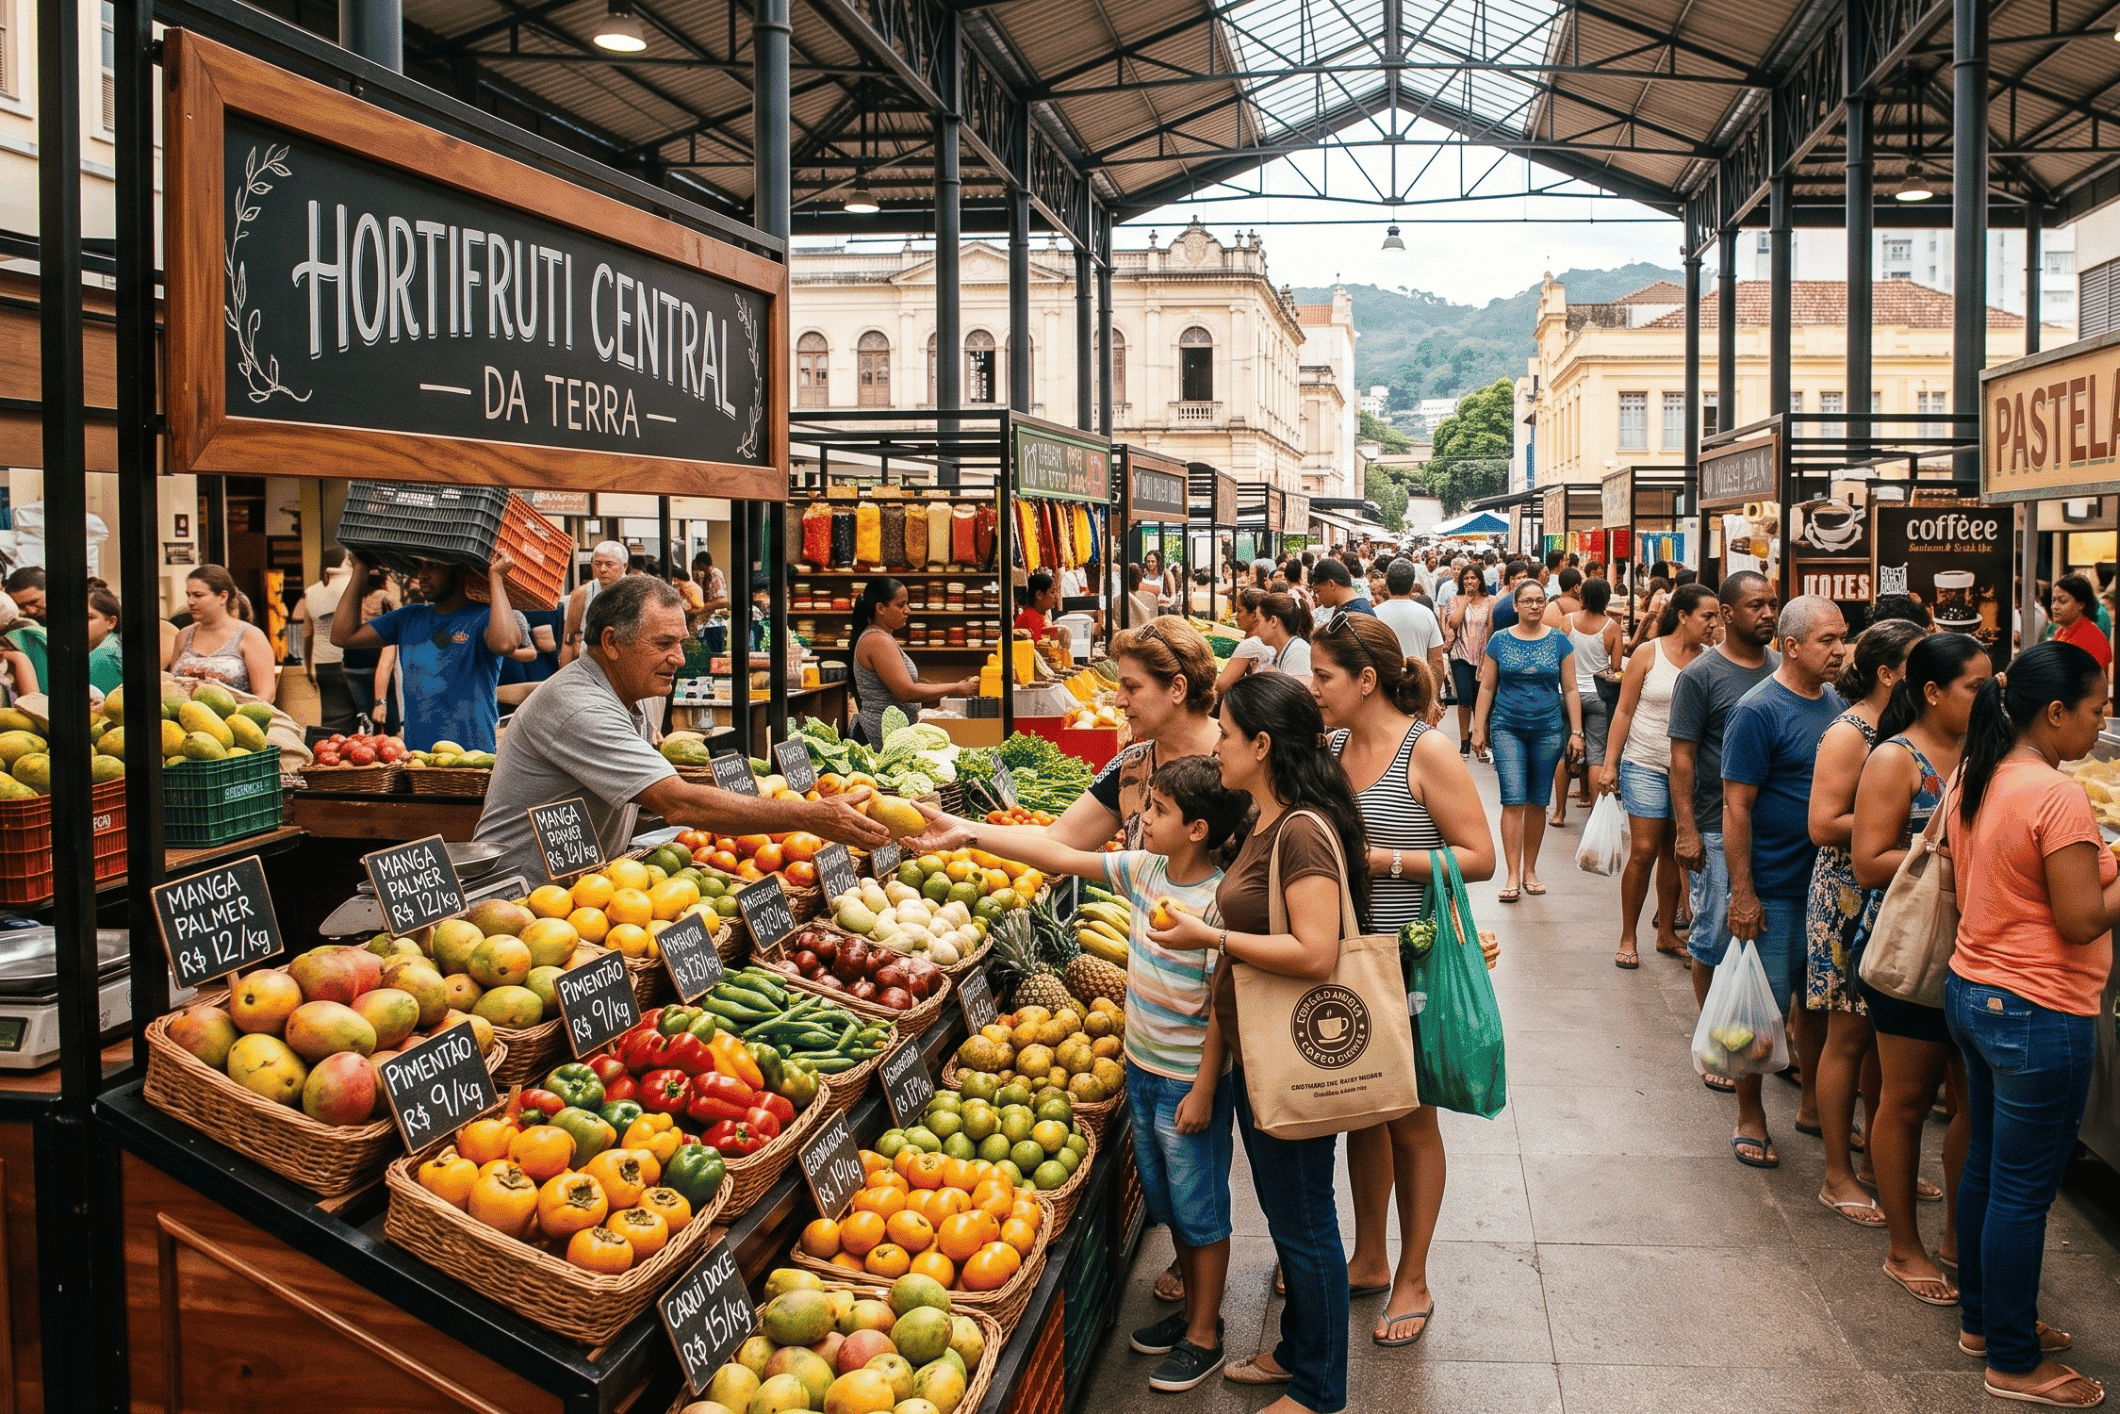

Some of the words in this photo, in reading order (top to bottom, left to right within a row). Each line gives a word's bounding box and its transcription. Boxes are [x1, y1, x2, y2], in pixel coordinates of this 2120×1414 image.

[292, 200, 573, 360] HORTIFRUTI
[590, 261, 738, 420] CENTRAL
[484, 365, 530, 424] DA
[544, 375, 640, 438] TERRA
[535, 804, 581, 831] MANGA
[377, 846, 437, 880] MANGA
[387, 867, 445, 901] PALMER
[166, 871, 242, 915] MANGA
[174, 894, 255, 941] PALMER
[392, 904, 415, 929] R$
[179, 950, 207, 979] R$
[559, 959, 624, 999] PIMENTÃO
[573, 1014, 593, 1044] R$
[592, 996, 631, 1031] 9/kg
[403, 1101, 430, 1137] R$
[430, 1078, 484, 1117] 9/kg
[703, 1250, 736, 1295] DOCE
[682, 1333, 709, 1375] R$
